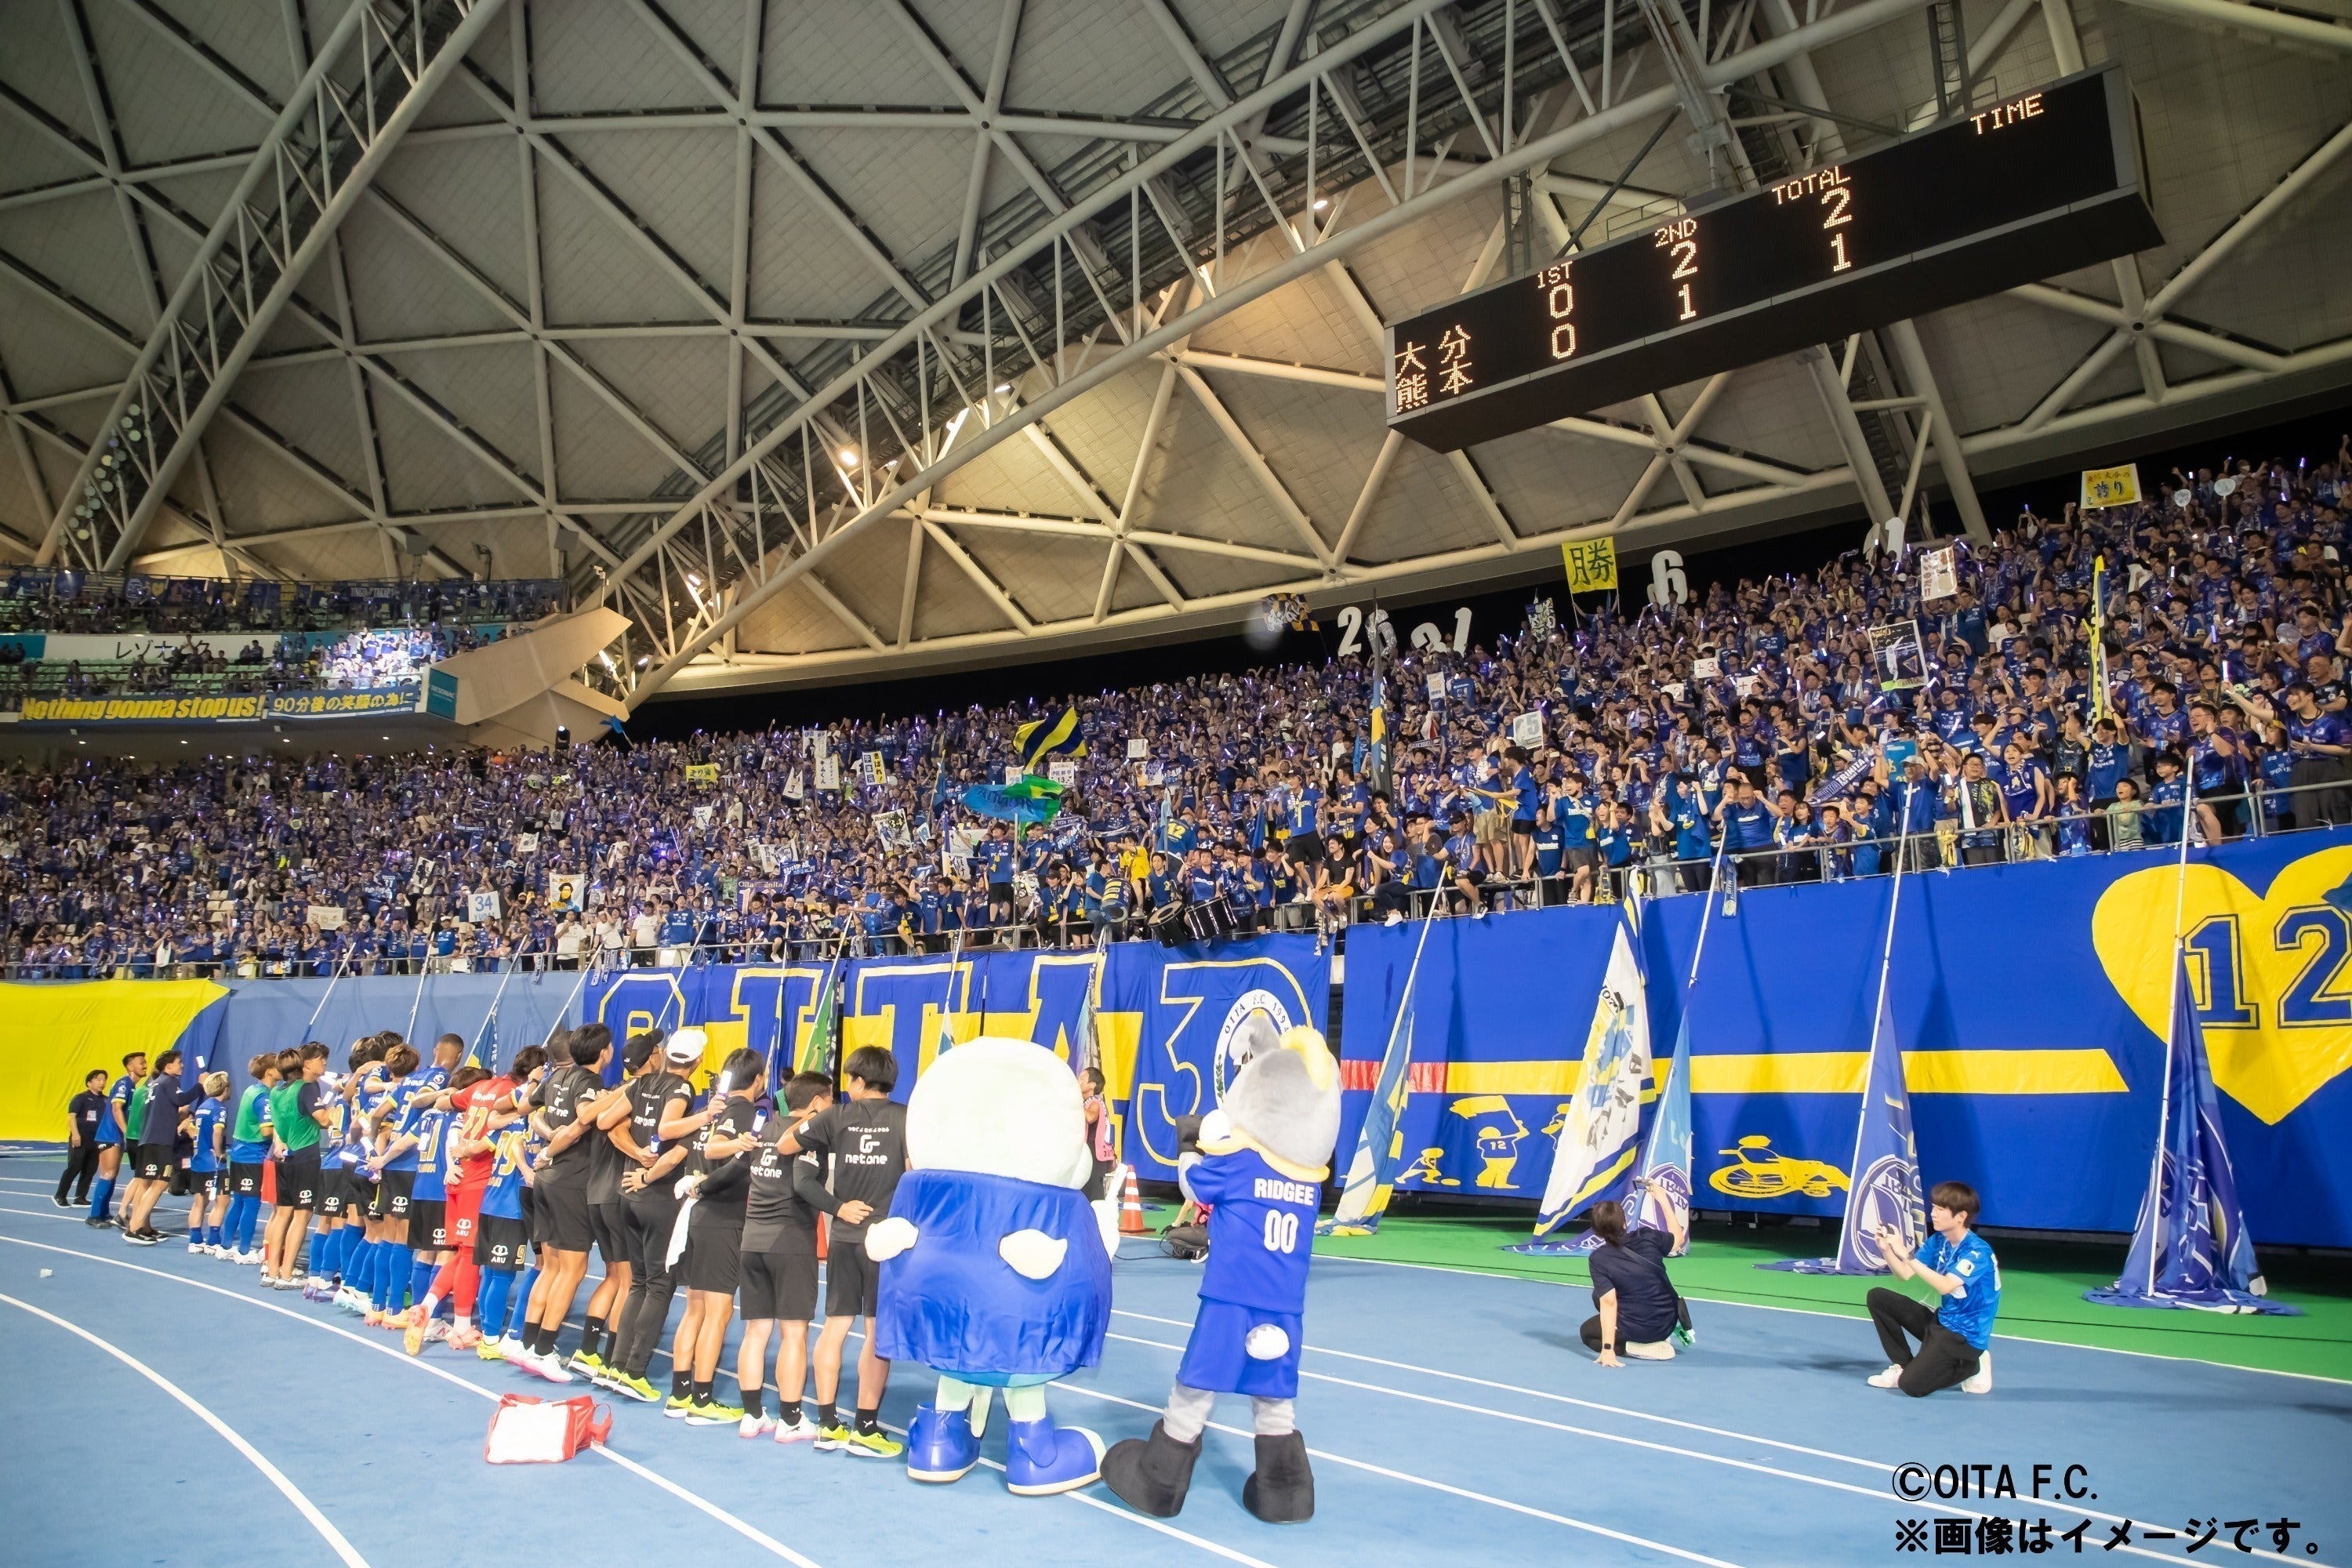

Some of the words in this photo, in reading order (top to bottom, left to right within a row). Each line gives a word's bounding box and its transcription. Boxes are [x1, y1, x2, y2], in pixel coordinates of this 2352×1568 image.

[1537, 260, 1573, 289] 1ST
[1654, 218, 1697, 248] 2ND
[1771, 165, 1851, 205] TOTAL
[1969, 93, 2044, 135] TIME
[1549, 283, 1573, 319] 0
[1671, 240, 1698, 280] 2
[1821, 187, 1853, 229] 2
[1552, 323, 1576, 359] 0
[1679, 283, 1697, 321] 1
[1831, 232, 1852, 272] 1
[2093, 480, 2123, 499] 誇り
[1570, 541, 1614, 586] 勝
[117, 640, 210, 660] レゾナク
[20, 697, 104, 720] Nothing
[104, 699, 177, 720] gonna
[178, 696, 227, 718] stop
[226, 695, 267, 717] us!
[1835, 758, 1866, 786] TRINITA
[1167, 822, 1187, 838] 12
[474, 895, 493, 912] 34
[2183, 903, 2352, 1030] 12
[1490, 1140, 1508, 1151] 12
[845, 1153, 888, 1165] netone
[1254, 1178, 1315, 1207] RIDGEE
[1264, 1209, 1299, 1254] 00
[491, 1255, 506, 1264] ARU
